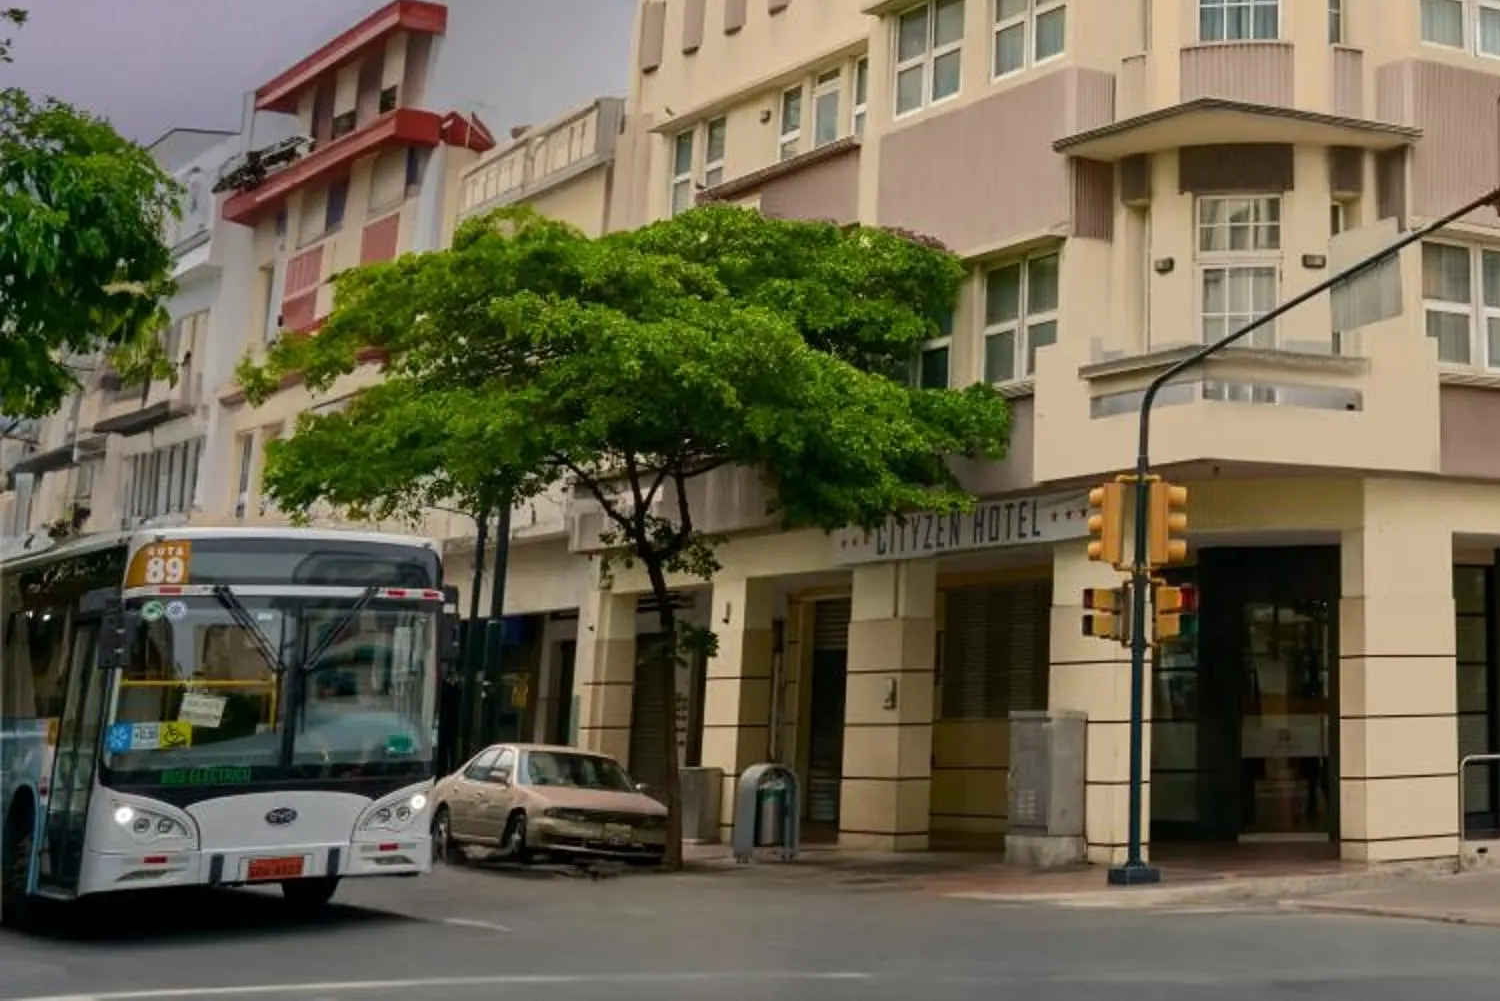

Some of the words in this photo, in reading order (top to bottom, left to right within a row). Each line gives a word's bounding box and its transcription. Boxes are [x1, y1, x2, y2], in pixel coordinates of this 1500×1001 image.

[875, 510, 962, 556] CITYZEN
[972, 499, 1042, 544] HOTEL
[146, 556, 185, 584] 89
